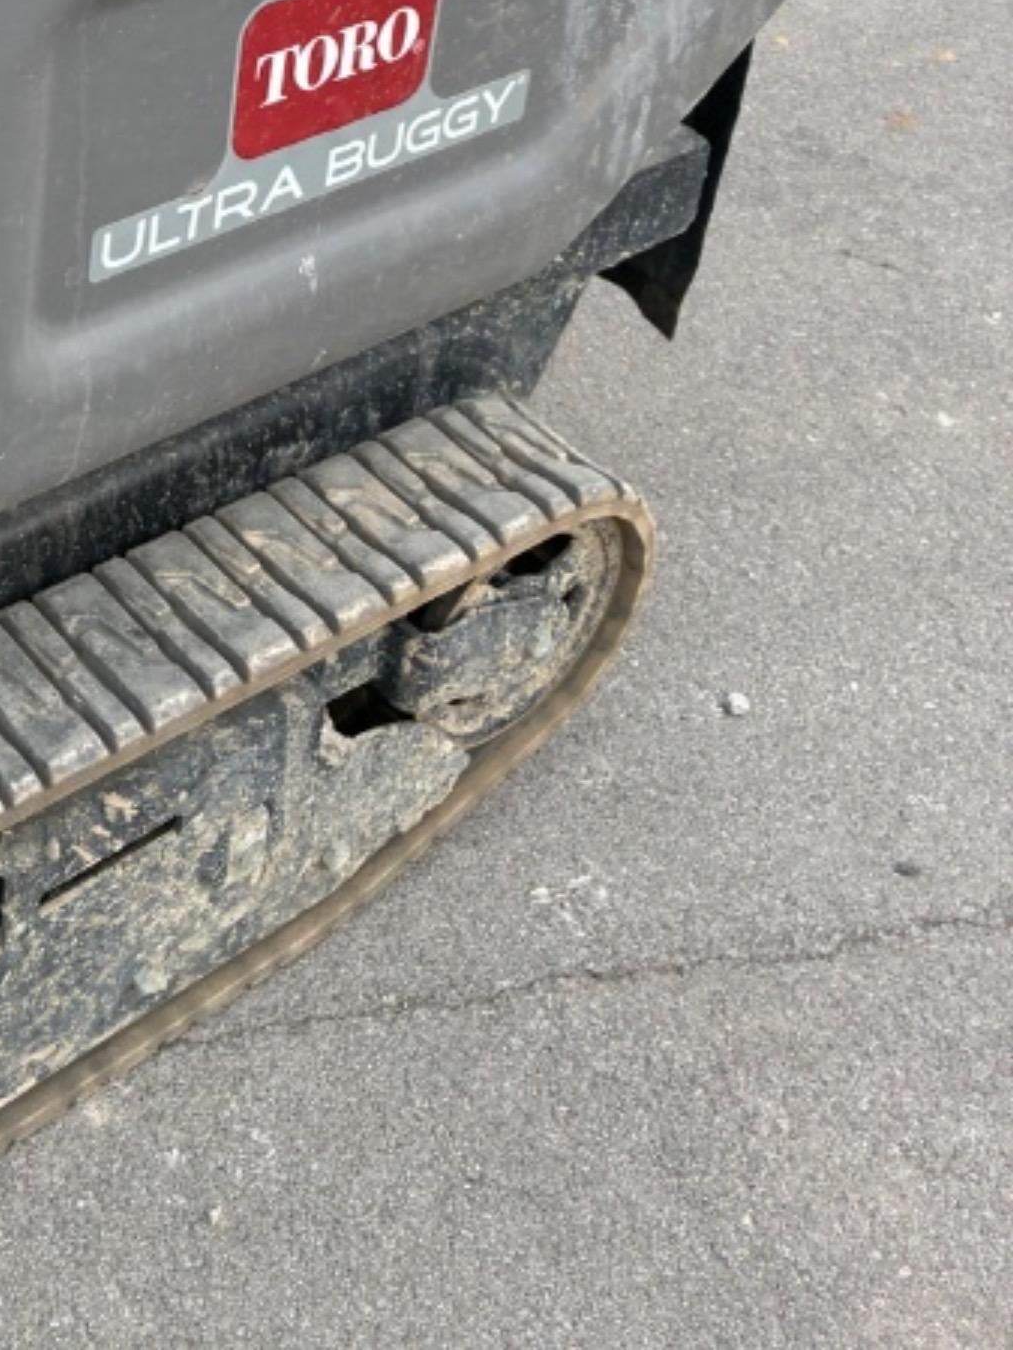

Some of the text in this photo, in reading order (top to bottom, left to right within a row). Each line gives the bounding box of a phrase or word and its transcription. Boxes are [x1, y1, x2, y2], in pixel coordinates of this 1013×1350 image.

[254, 7, 420, 107] TORO
[100, 83, 516, 270] ULTRA BUGGY
